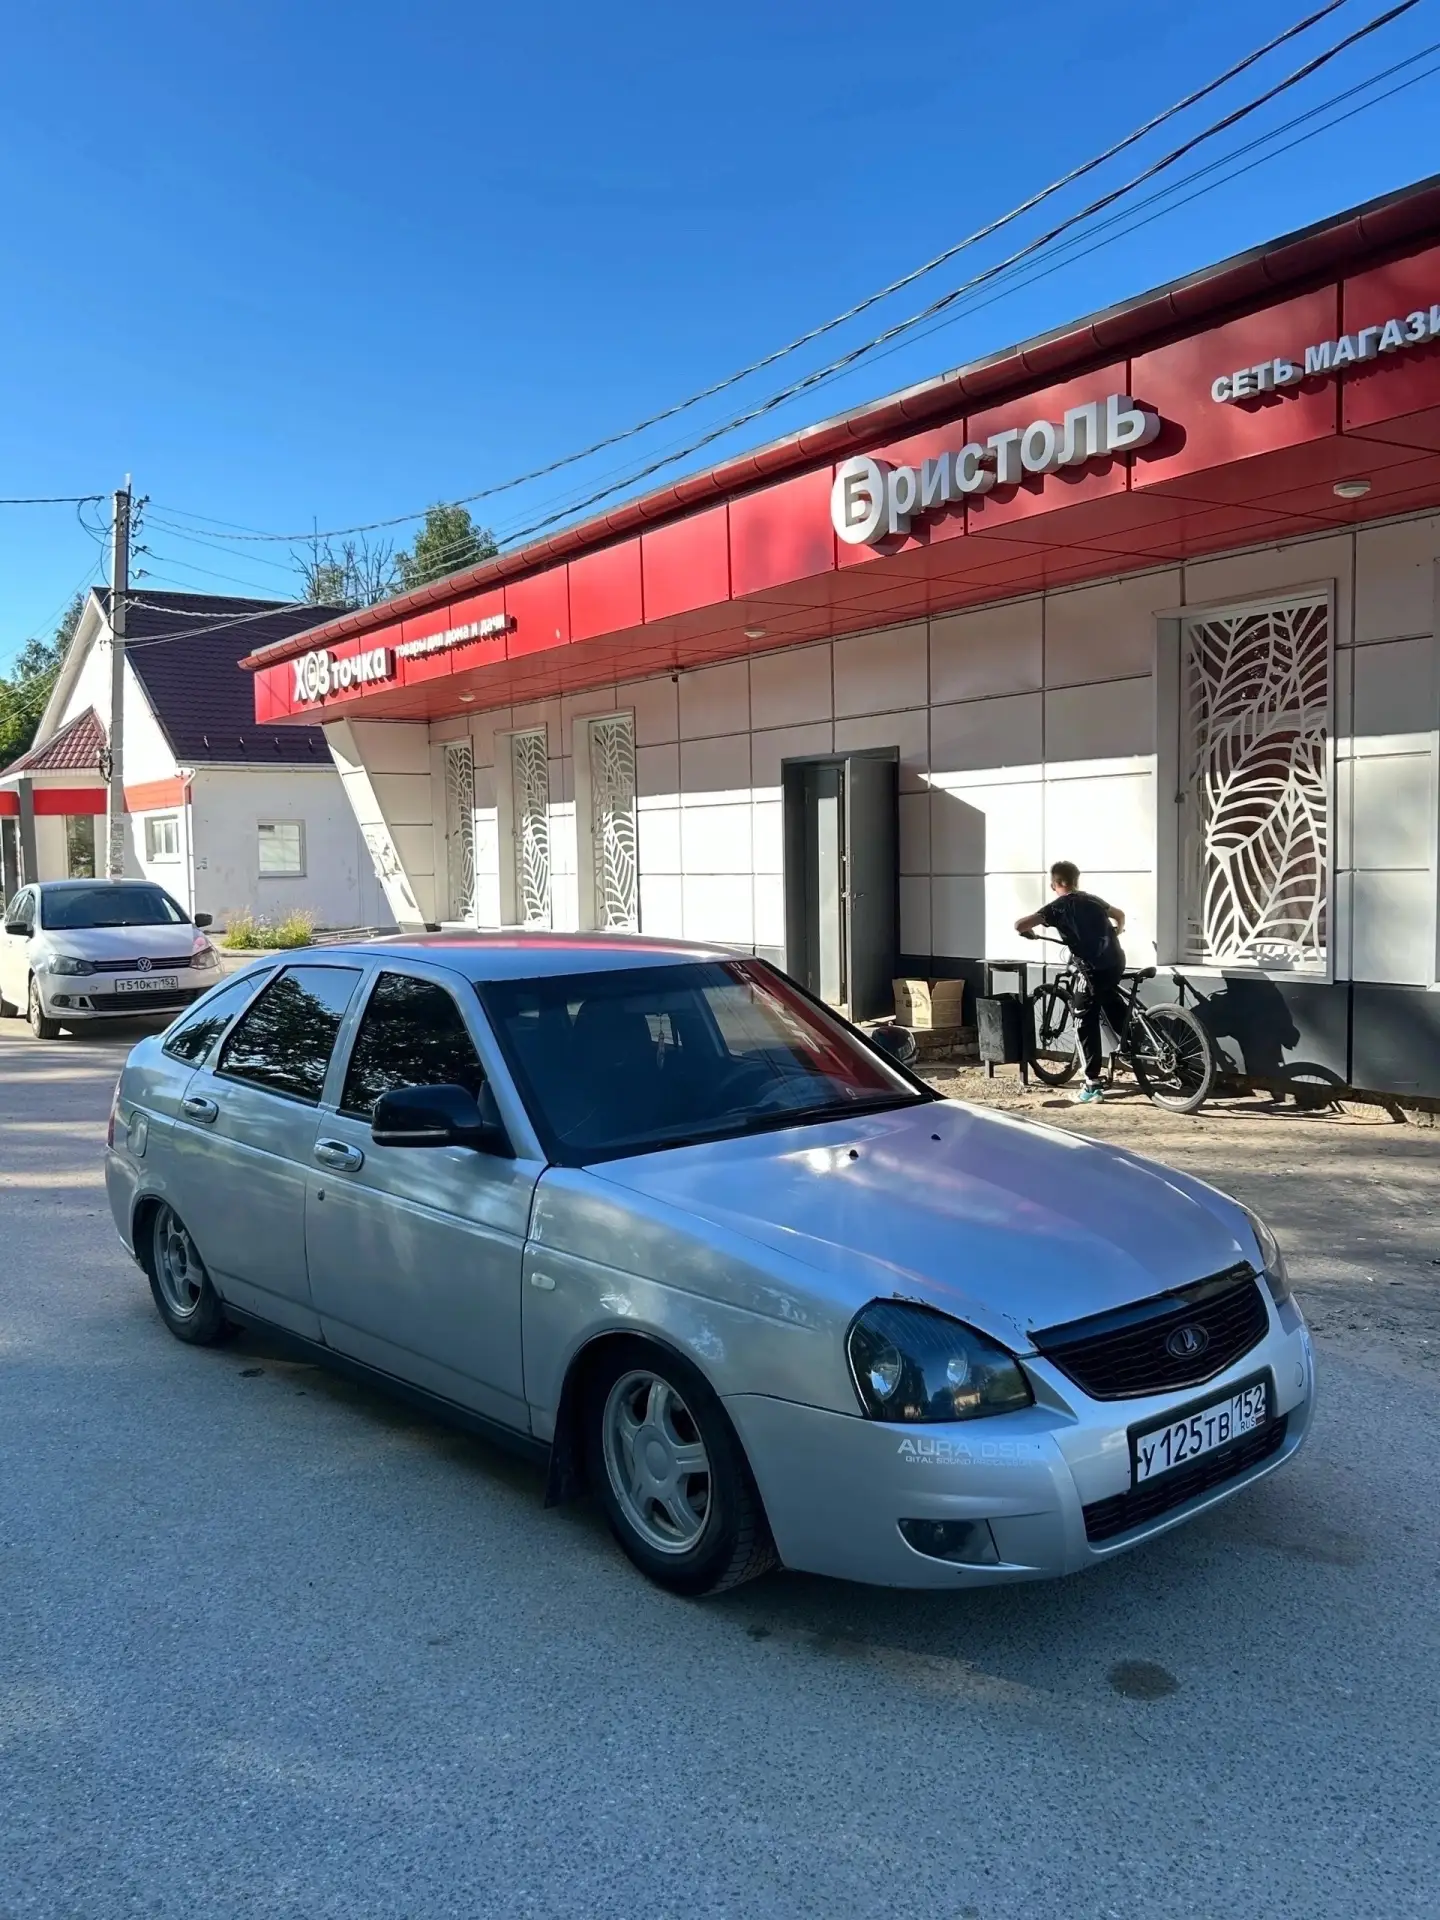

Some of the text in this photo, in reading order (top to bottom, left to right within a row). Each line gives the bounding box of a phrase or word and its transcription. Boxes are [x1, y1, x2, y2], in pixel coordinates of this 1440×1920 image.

[1211, 358, 1297, 403] СЕТЬ
[161, 978, 176, 986] 152
[1142, 1386, 1262, 1476] У125ТВ 152
[1240, 1416, 1256, 1432] RUS
[897, 1438, 1029, 1458] AURA DSP
